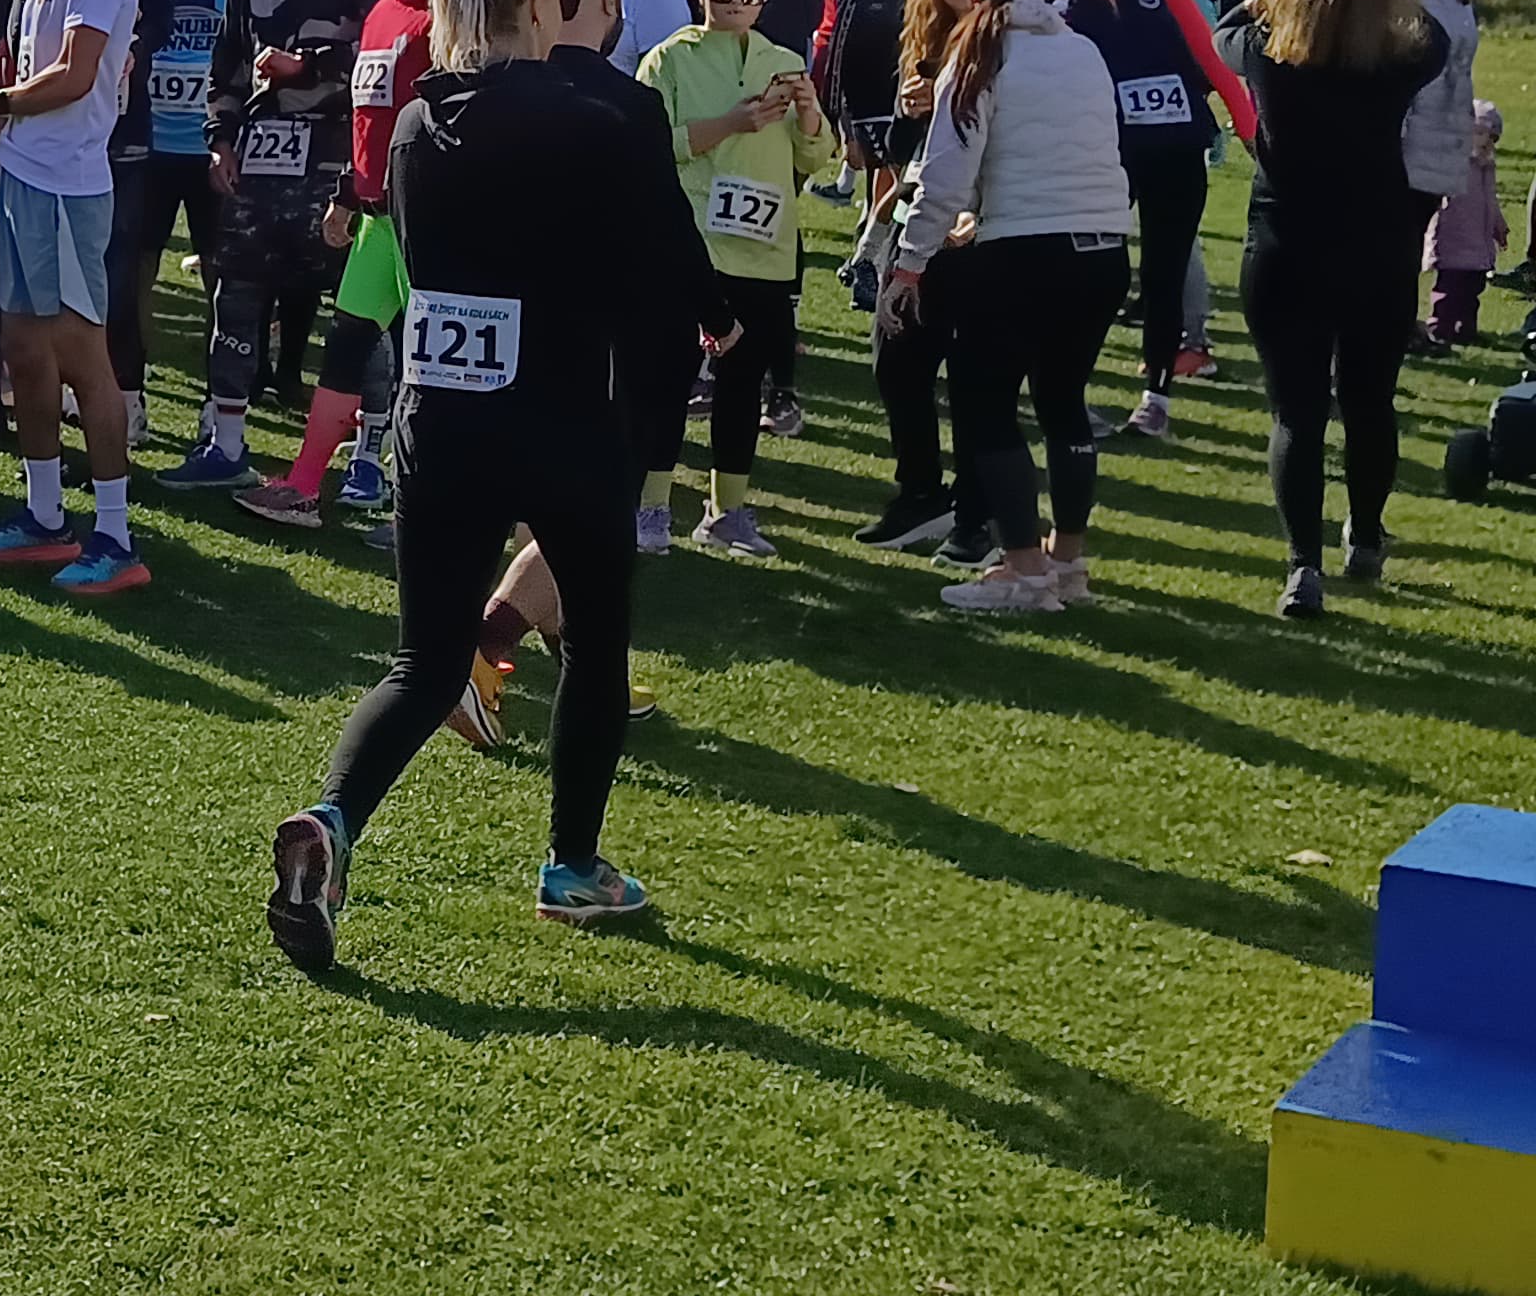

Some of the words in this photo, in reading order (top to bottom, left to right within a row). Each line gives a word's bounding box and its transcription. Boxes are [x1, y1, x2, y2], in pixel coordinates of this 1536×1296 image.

[151, 75, 205, 101] 197
[1128, 86, 1184, 112] 194
[248, 132, 303, 161] 224
[715, 191, 779, 228] 127
[410, 317, 505, 371] 121
